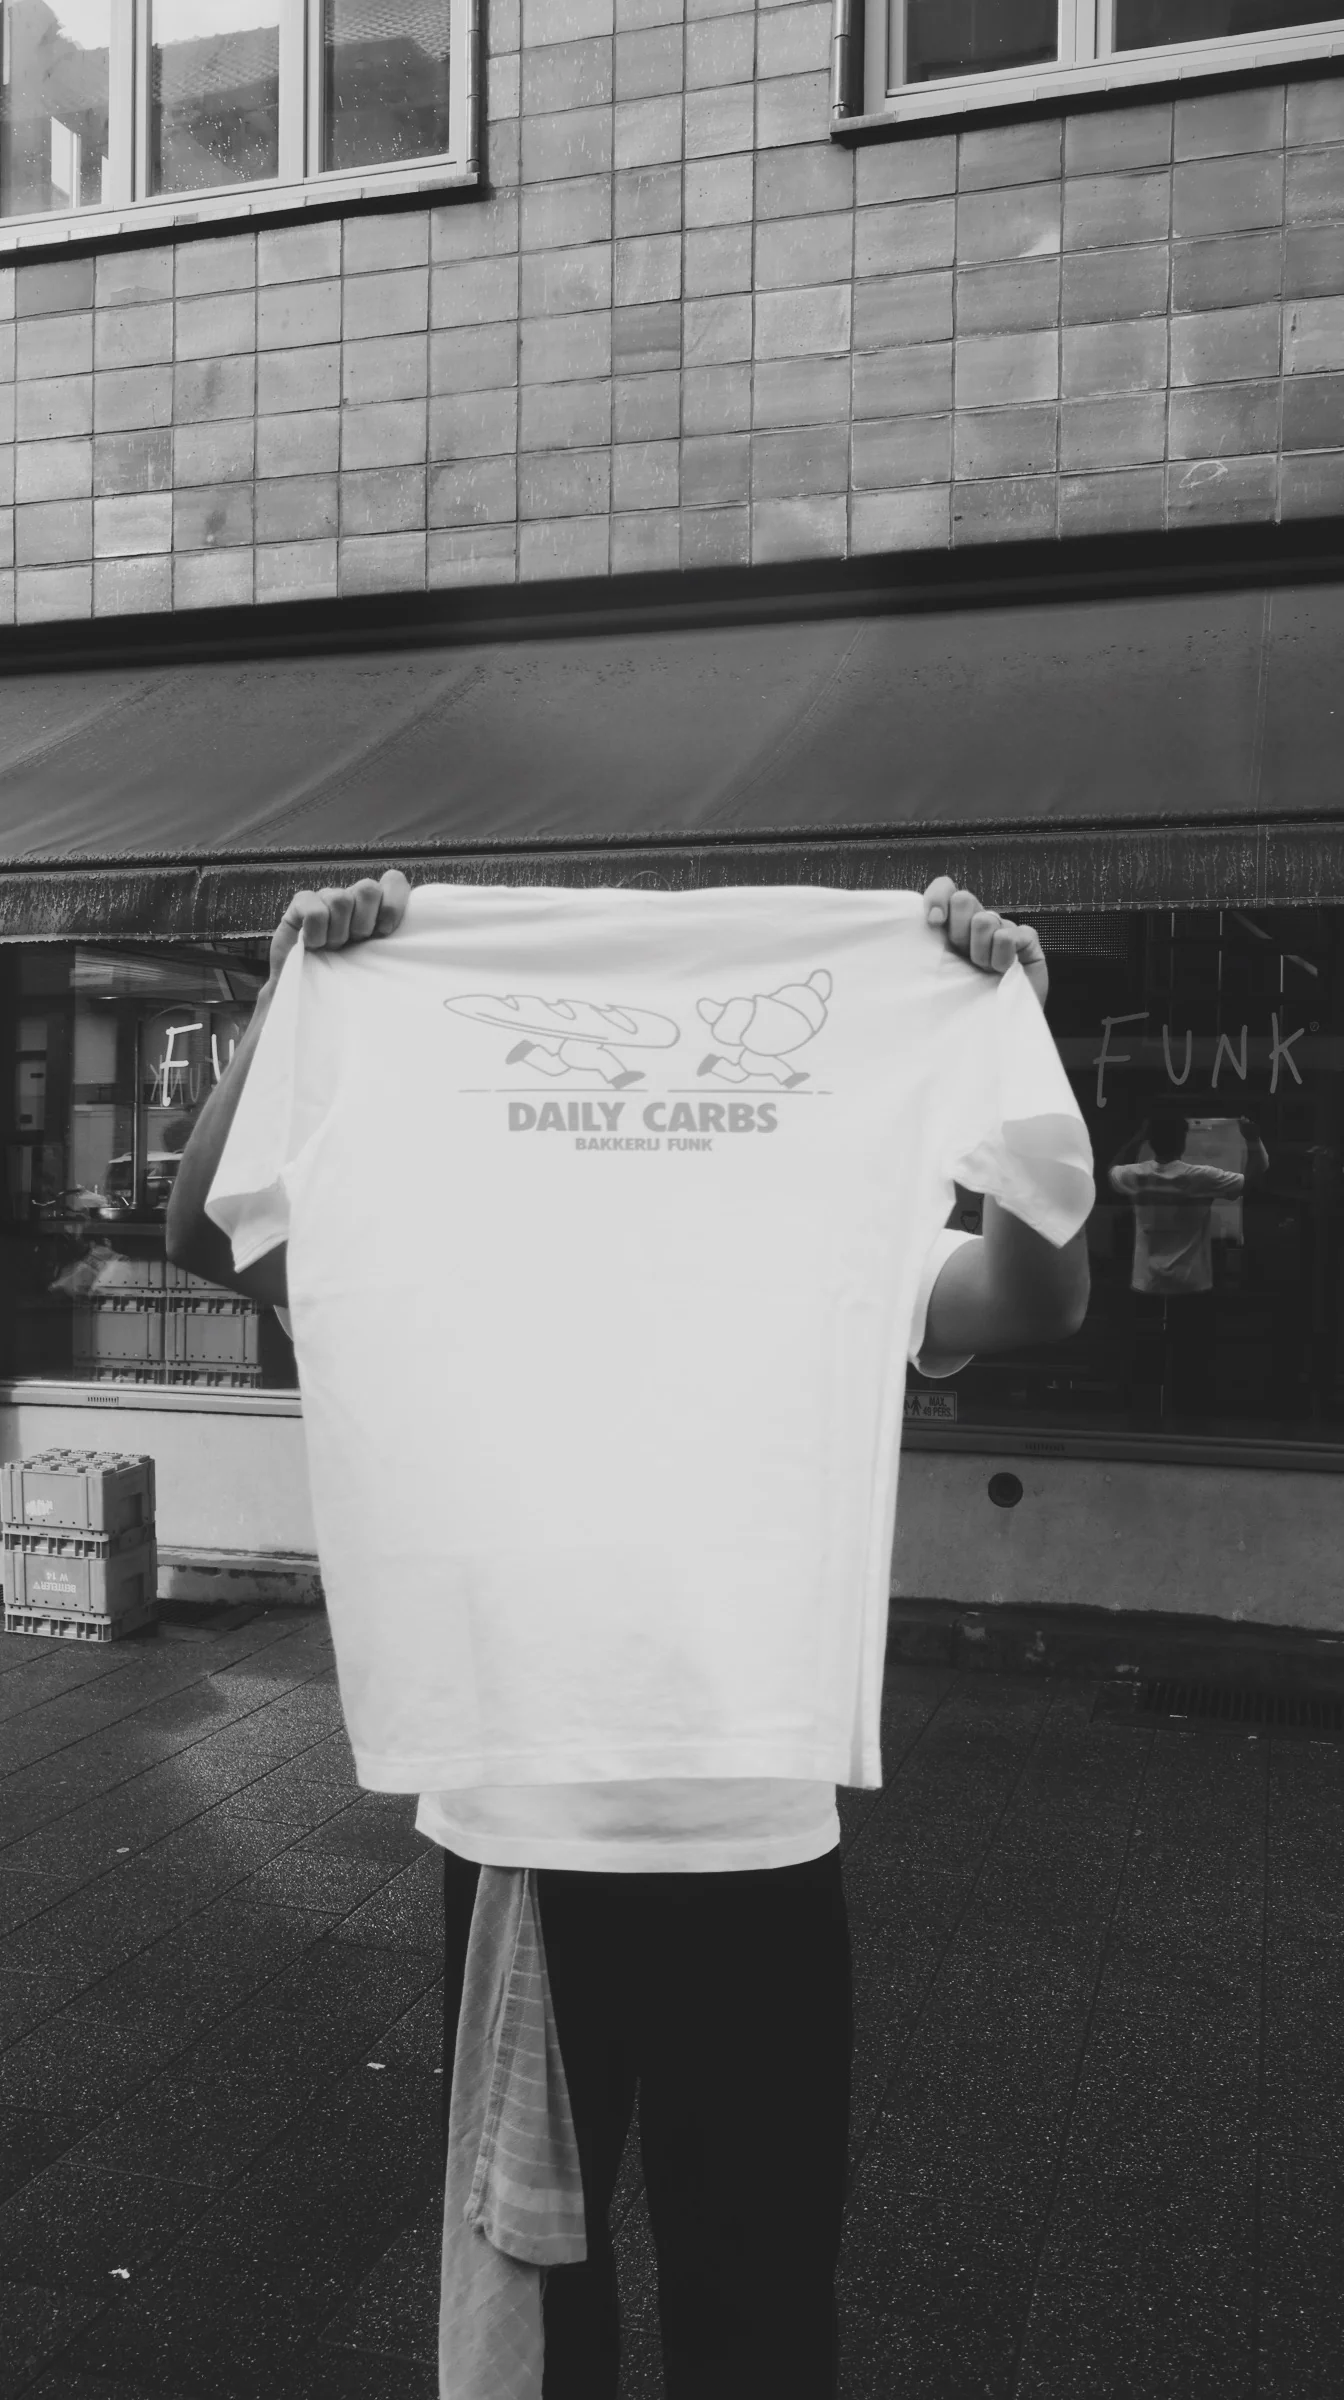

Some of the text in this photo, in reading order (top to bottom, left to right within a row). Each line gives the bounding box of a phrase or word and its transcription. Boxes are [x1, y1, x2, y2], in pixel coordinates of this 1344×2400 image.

[1093, 1012, 1305, 1109] FUNK
[508, 1102, 778, 1133] DAILY CARBS
[575, 1138, 713, 1151] BAKKERIJ FUNK
[929, 1396, 947, 1407] MAX.
[933, 1407, 952, 1417] PERS.
